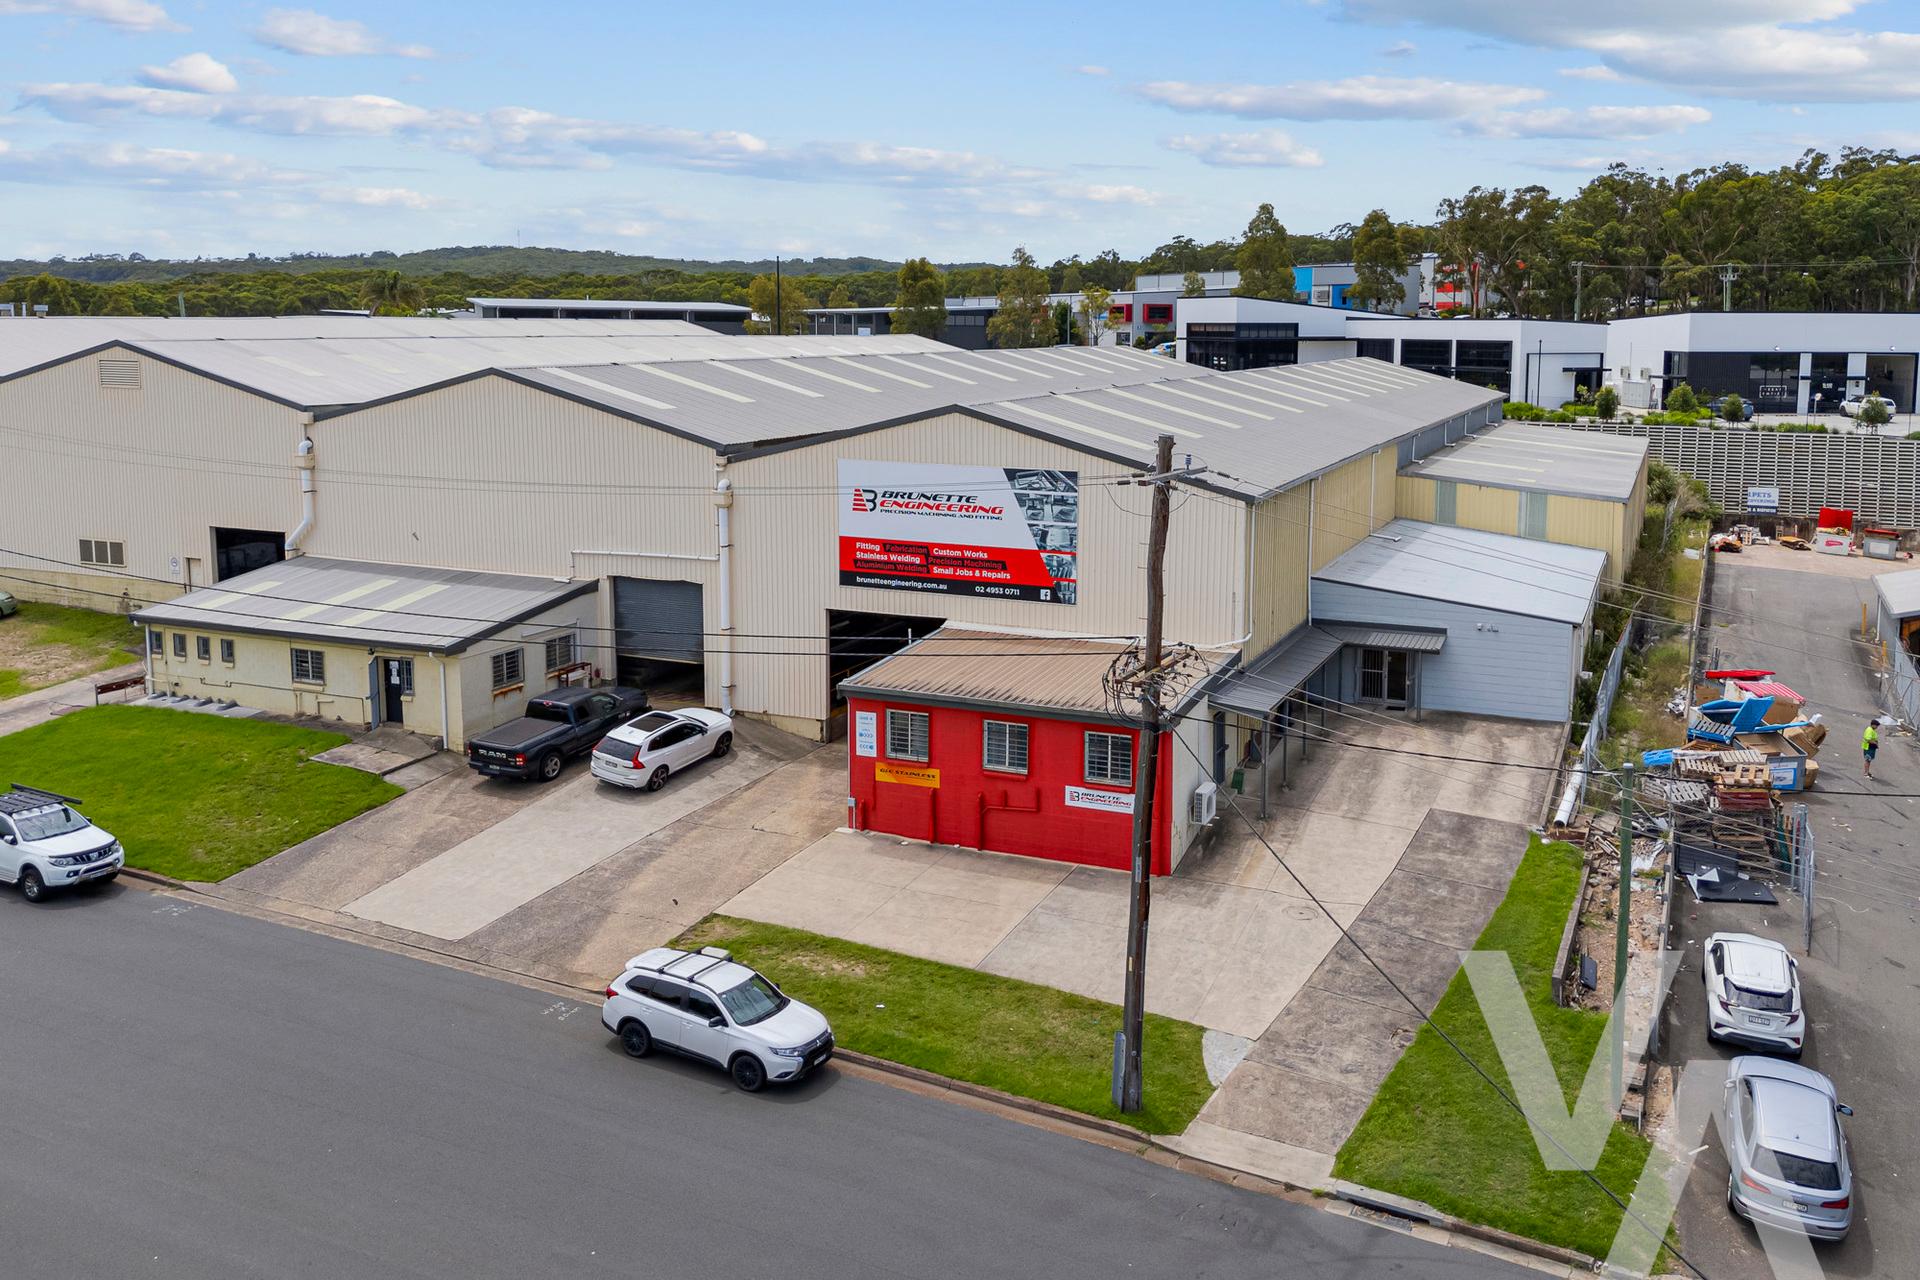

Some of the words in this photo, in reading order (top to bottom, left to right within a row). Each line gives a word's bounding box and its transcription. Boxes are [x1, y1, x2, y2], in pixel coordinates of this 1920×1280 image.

[881, 490, 978, 504] BRUNETTE
[879, 499, 1004, 515] ENGINEERING
[880, 508, 917, 516] PRECISION
[856, 542, 880, 552] Fitting
[885, 544, 928, 555] Fabrication
[933, 547, 962, 557] Custom
[963, 549, 988, 559] Works
[856, 551, 888, 561] Stainless
[890, 553, 921, 564] Welding
[928, 556, 963, 566] Precision
[964, 560, 1003, 570] Machining
[856, 560, 895, 571] Aluminium
[896, 563, 928, 574] Welding
[933, 566, 954, 575] Small
[955, 568, 973, 577] Jobs
[982, 570, 1011, 580] Repairs
[856, 575, 948, 590] brunetteengineering.com.au
[975, 585, 985, 593] 02
[985, 586, 1003, 595] 4953
[1004, 587, 1020, 596] 0711
[478, 749, 507, 760] RAM
[895, 770, 936, 779] STAINLESS
